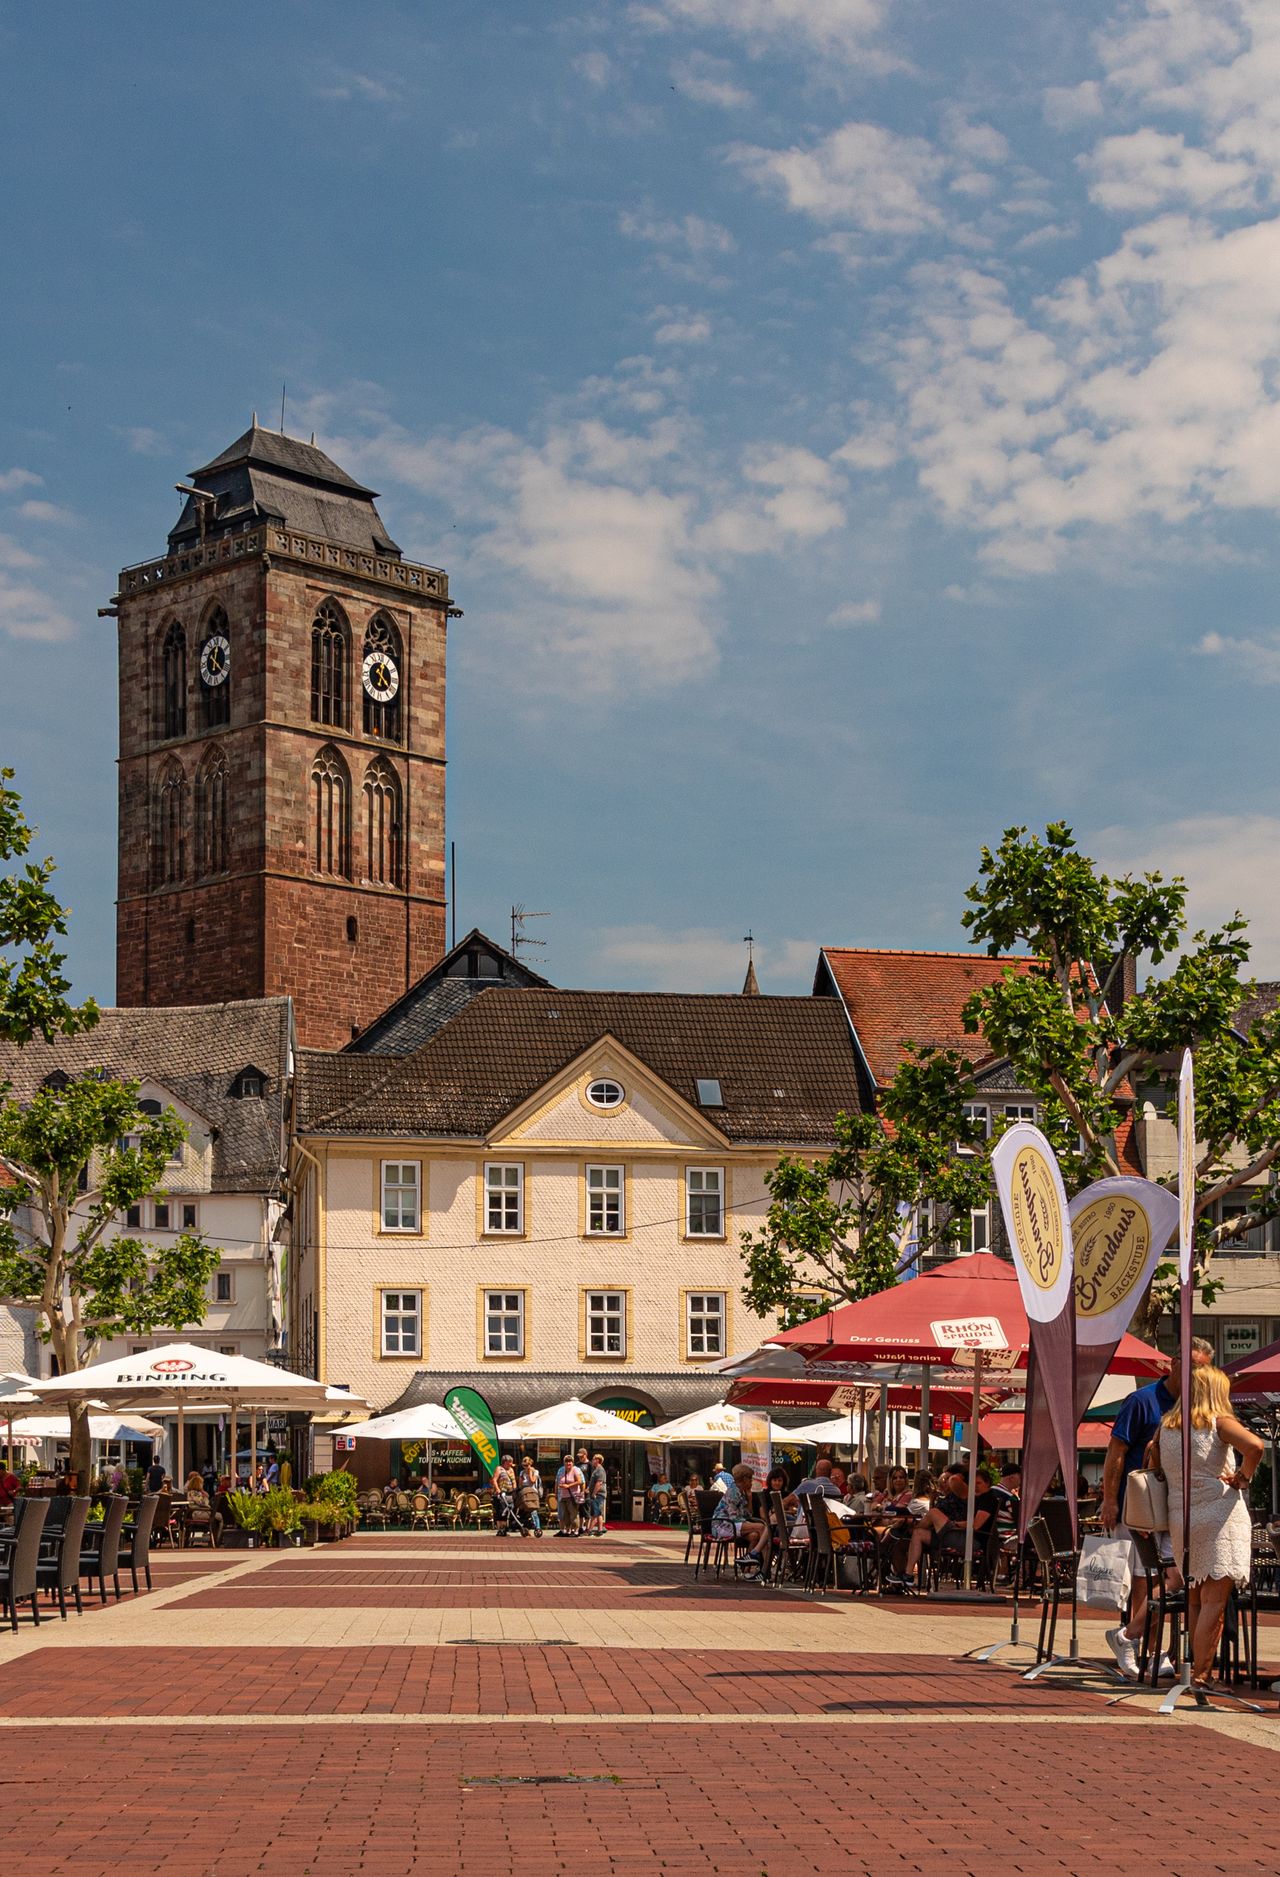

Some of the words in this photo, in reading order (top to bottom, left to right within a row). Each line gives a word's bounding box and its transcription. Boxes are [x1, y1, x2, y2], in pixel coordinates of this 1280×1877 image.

[1103, 1202, 1116, 1220] 1950
[1080, 1210, 1097, 1231] BISTRO
[1075, 1207, 1136, 1312] Brandaus
[1111, 1235, 1145, 1300] BACKSTUBE
[941, 1322, 992, 1334] RHÖN
[1227, 1328, 1256, 1340] HDI
[875, 1336, 920, 1344] Genuss
[943, 1331, 996, 1340] SPRUDEL
[117, 1374, 228, 1383] BINDING
[446, 1456, 472, 1464] KUCHEN
